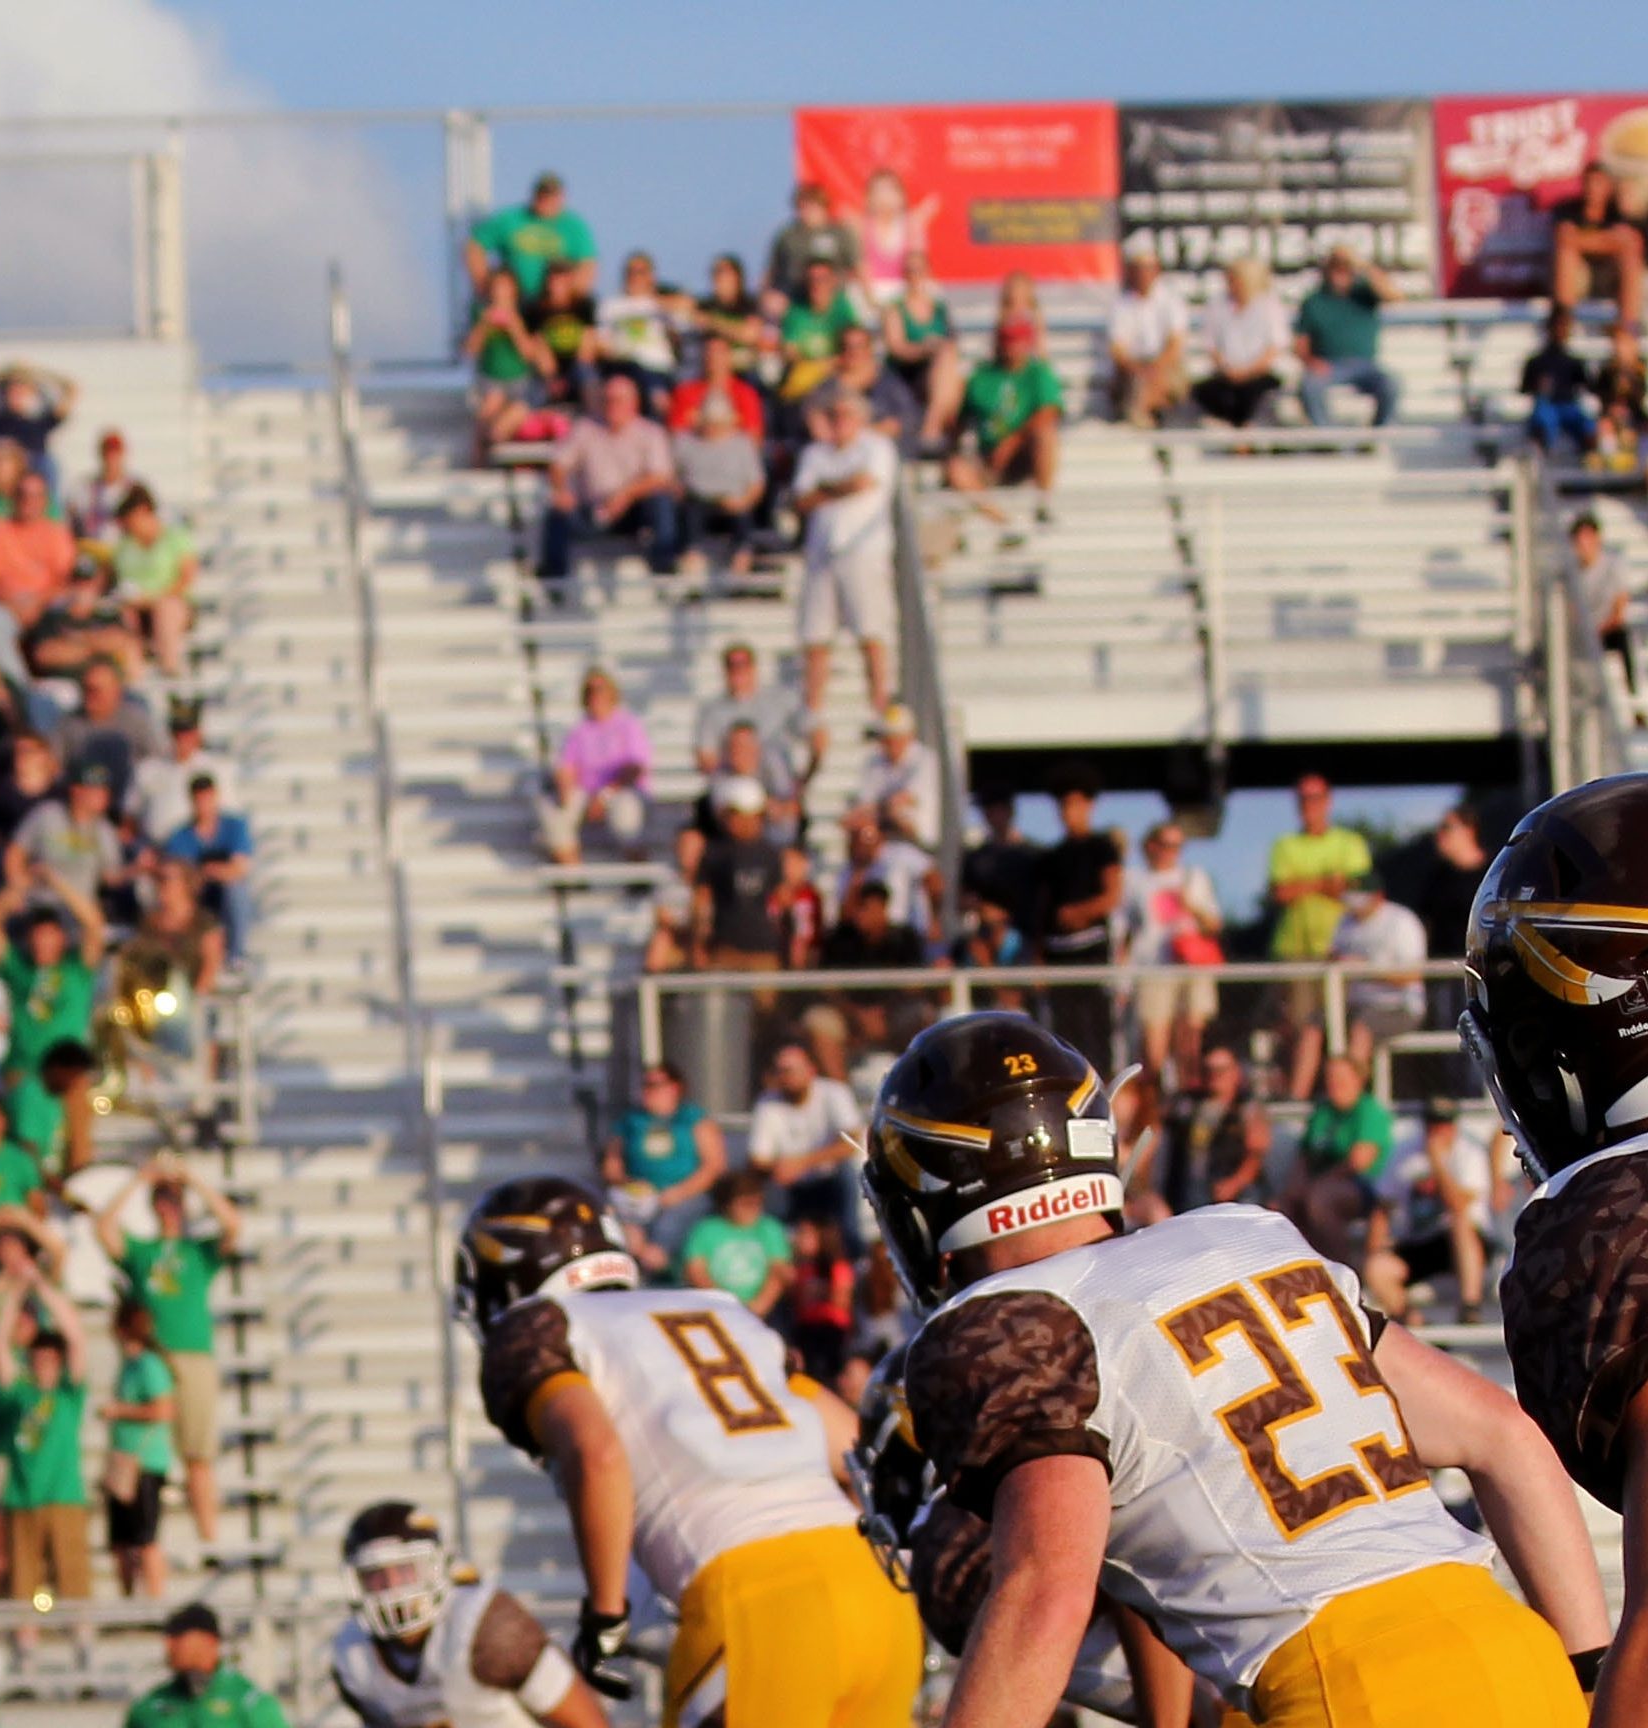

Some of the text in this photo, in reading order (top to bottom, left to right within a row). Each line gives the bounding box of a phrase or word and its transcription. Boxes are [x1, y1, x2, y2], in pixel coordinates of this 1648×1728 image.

[1003, 1053, 1038, 1077] 23
[987, 1179, 1108, 1236] Riddell
[649, 1309, 793, 1437] 8
[1156, 1258, 1430, 1543] 23
